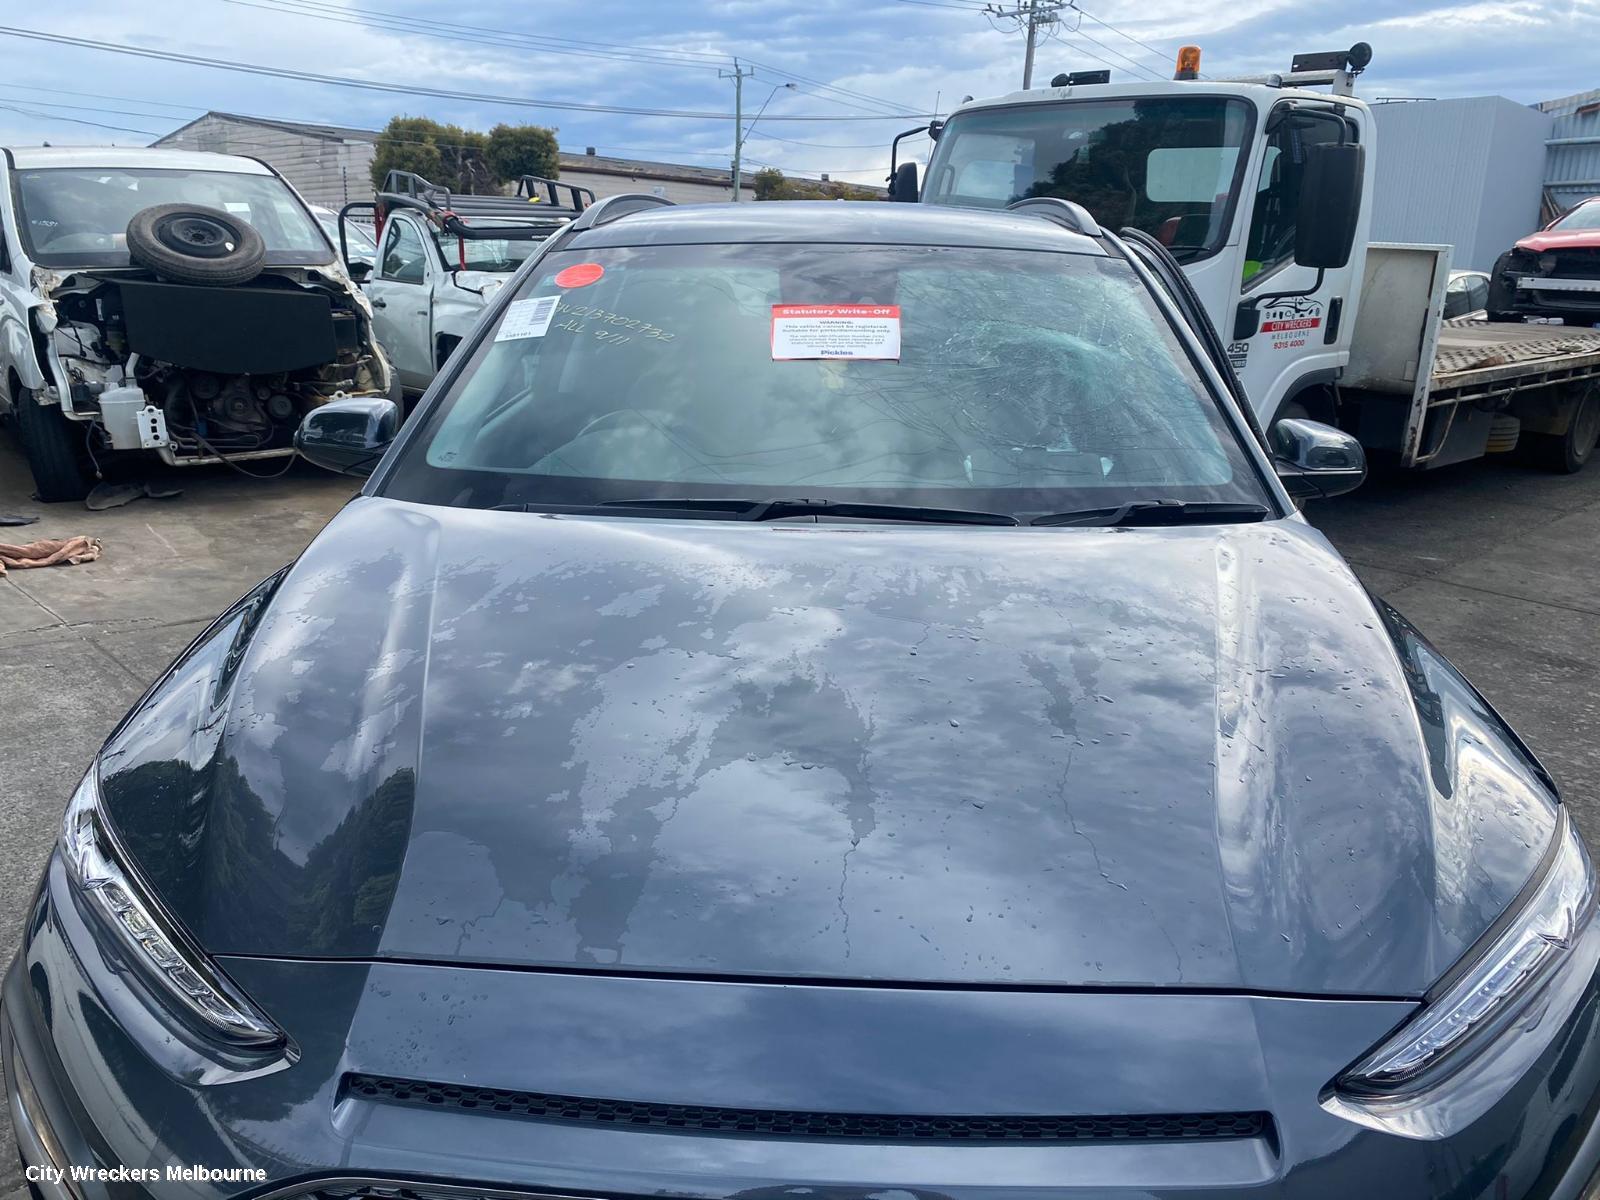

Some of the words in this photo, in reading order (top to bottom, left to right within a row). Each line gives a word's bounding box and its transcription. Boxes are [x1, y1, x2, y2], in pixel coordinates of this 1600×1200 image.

[782, 308, 836, 316] Statutory
[837, 308, 891, 316] Write-Off
[1271, 321, 1284, 331] CITY
[1285, 319, 1312, 330] WRECKERS
[1271, 331, 1310, 340] MELBOURNE
[1227, 342, 1249, 353] 450
[1273, 341, 1288, 350] 9315
[1289, 339, 1305, 348] 4000
